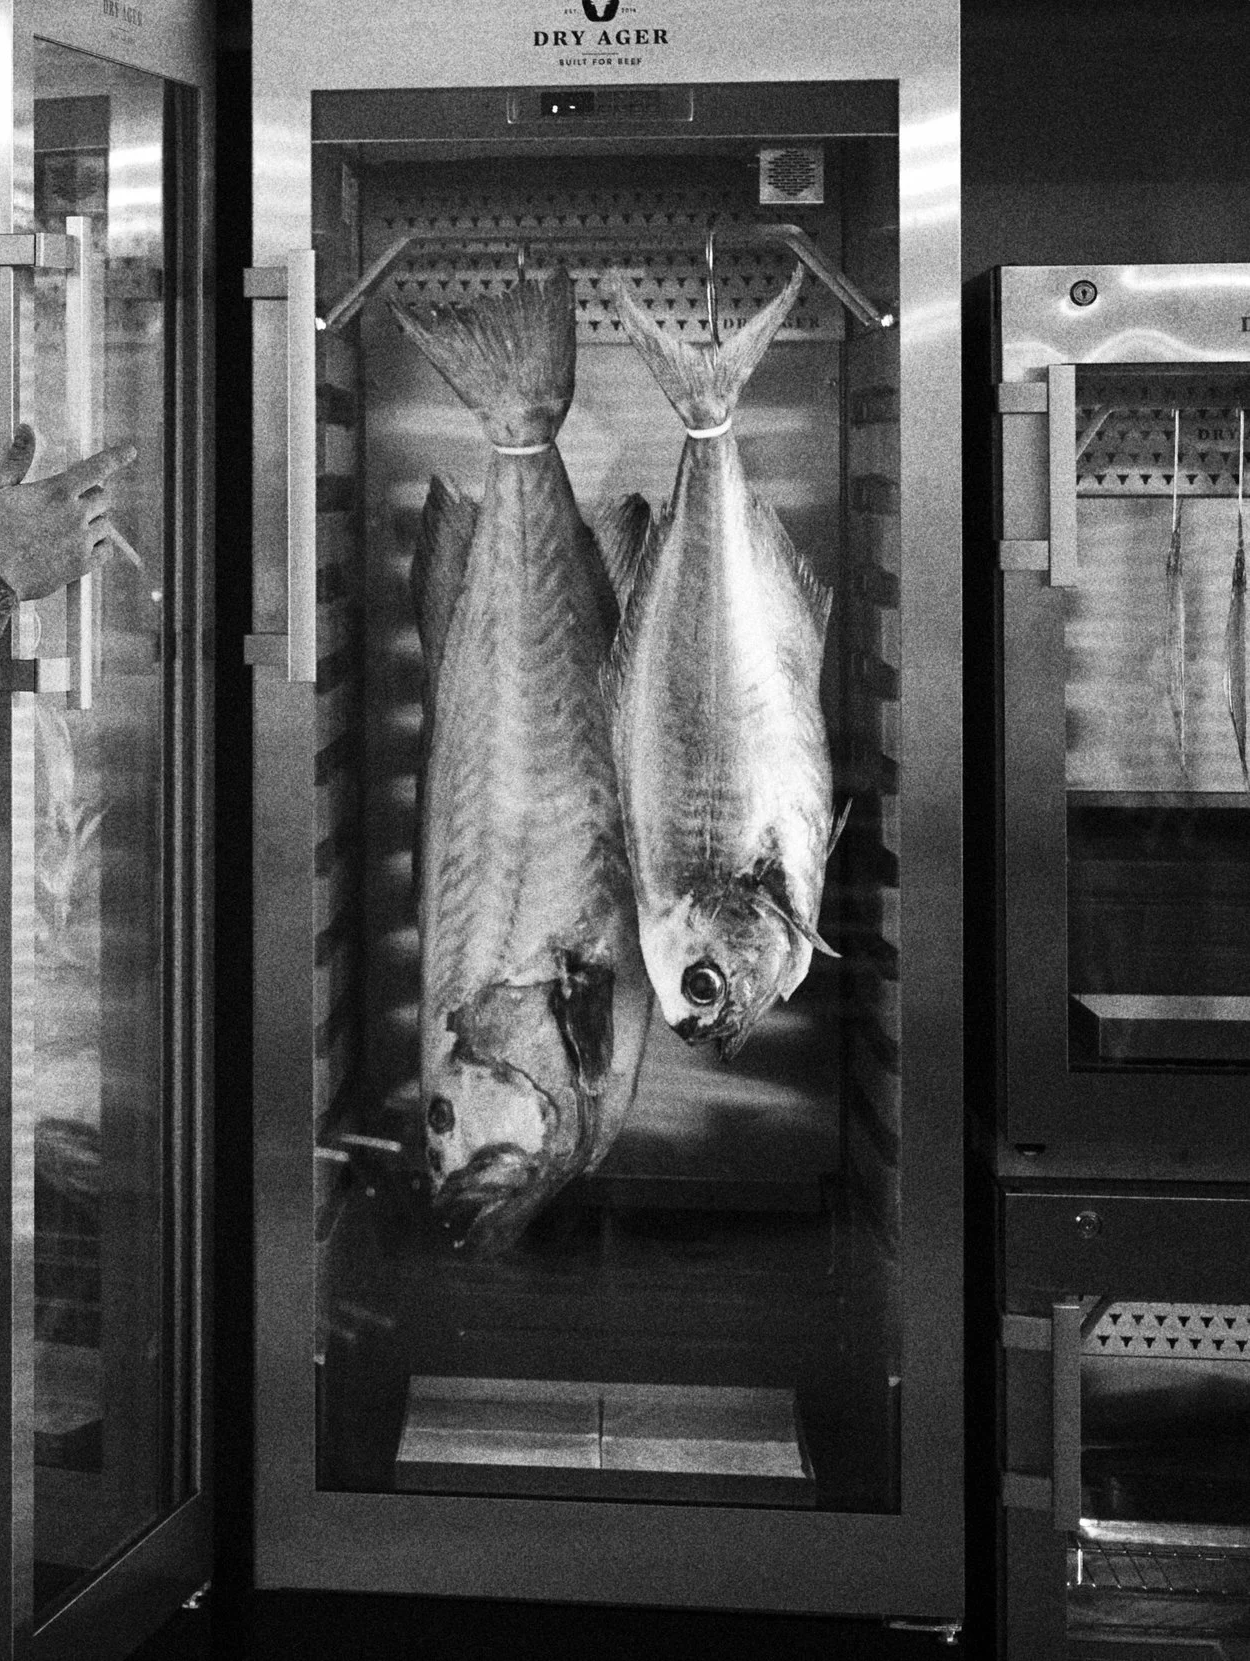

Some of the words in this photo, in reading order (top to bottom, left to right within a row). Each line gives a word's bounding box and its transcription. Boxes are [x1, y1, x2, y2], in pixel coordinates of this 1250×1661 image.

[533, 30, 586, 47] DRY
[597, 28, 669, 46] AGER
[559, 58, 587, 67] BUILT
[592, 58, 612, 66] FOR
[617, 57, 642, 66] BEEF
[1197, 428, 1239, 441] DRY
